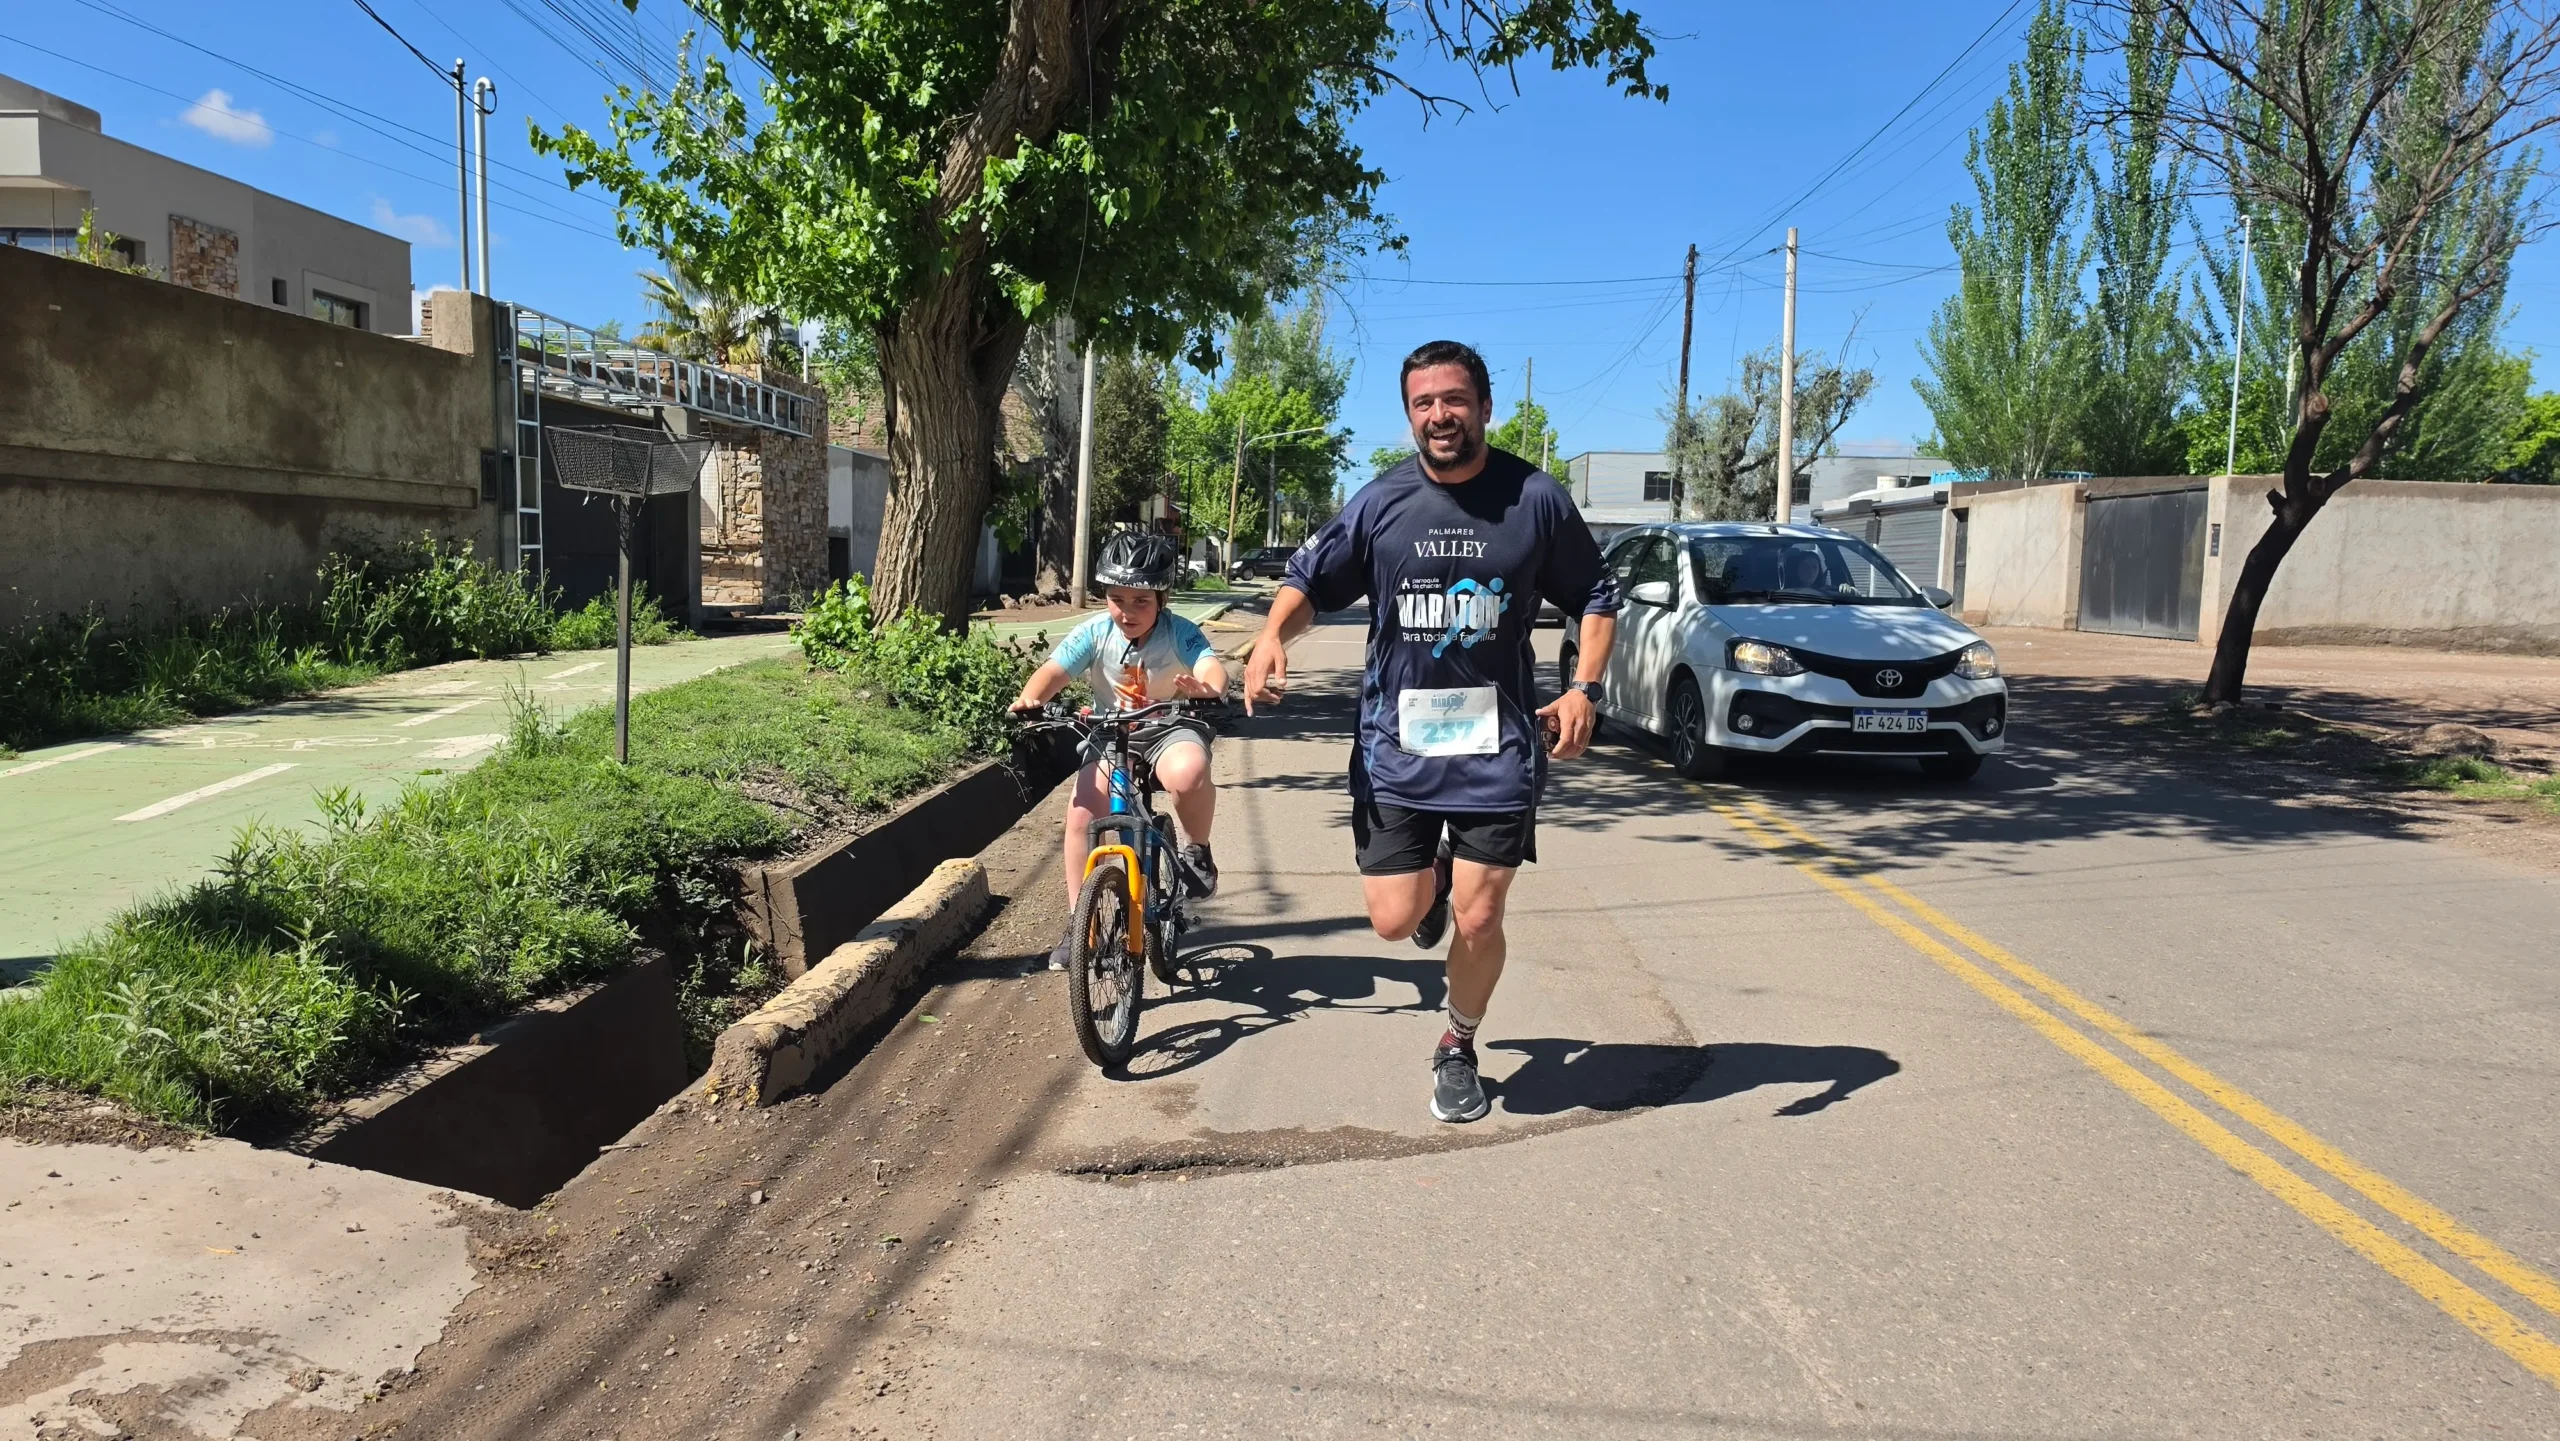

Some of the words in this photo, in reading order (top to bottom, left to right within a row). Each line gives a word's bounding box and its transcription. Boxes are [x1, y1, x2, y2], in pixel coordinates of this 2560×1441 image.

[1428, 528, 1474, 536] PALMARES
[1414, 540, 1488, 558] VALLEY
[1396, 593, 1501, 630] MARATON
[1423, 631, 1447, 643] toda
[1857, 716, 1874, 730] AF
[1878, 716, 1903, 730] 424
[1907, 717, 1924, 731] DS
[1421, 720, 1475, 744] 237
